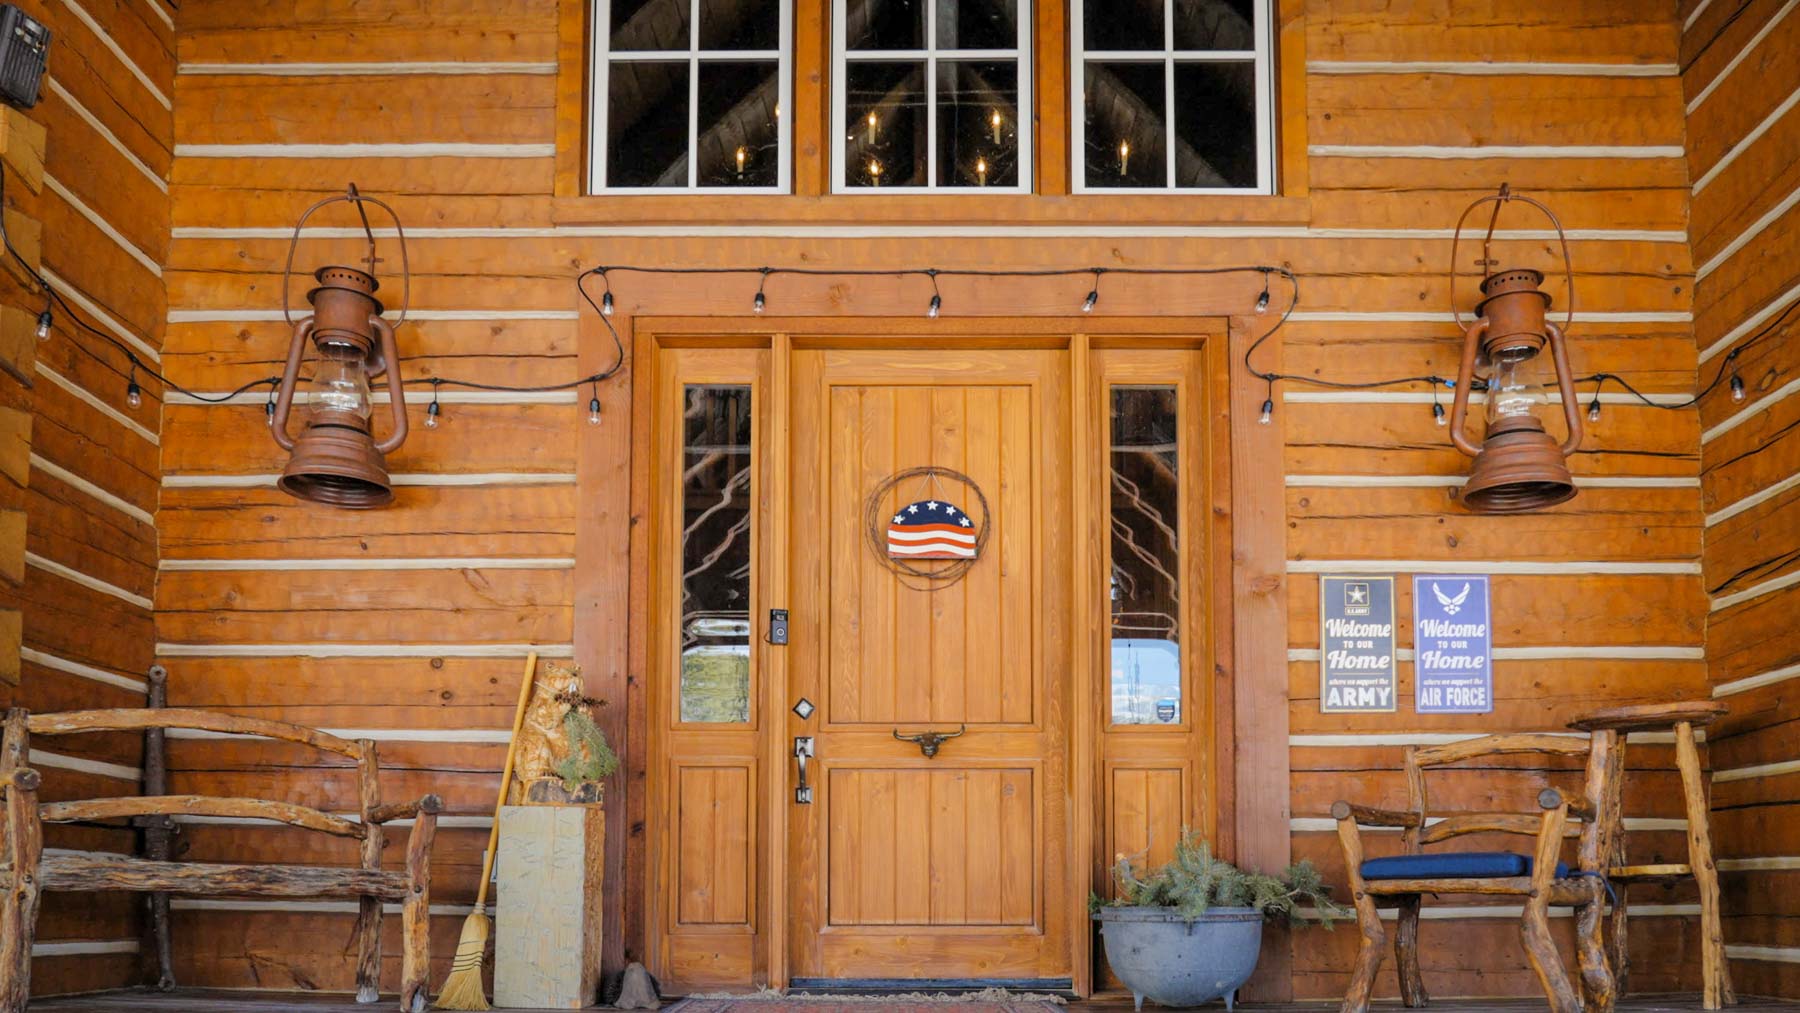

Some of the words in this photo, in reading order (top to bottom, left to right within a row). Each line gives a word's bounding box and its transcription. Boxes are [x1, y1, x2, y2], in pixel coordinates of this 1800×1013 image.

[1326, 618, 1391, 638] Welcome
[1420, 618, 1486, 638] Welcome
[1343, 640, 1354, 649] TO
[1357, 640, 1373, 649] OUR
[1438, 640, 1448, 649] TO
[1451, 640, 1468, 649] OUR
[1327, 650, 1390, 669] Home
[1422, 650, 1485, 669] Home
[1327, 687, 1391, 707] ARMY
[1421, 687, 1442, 707] AIR
[1446, 687, 1486, 707] FORCE
